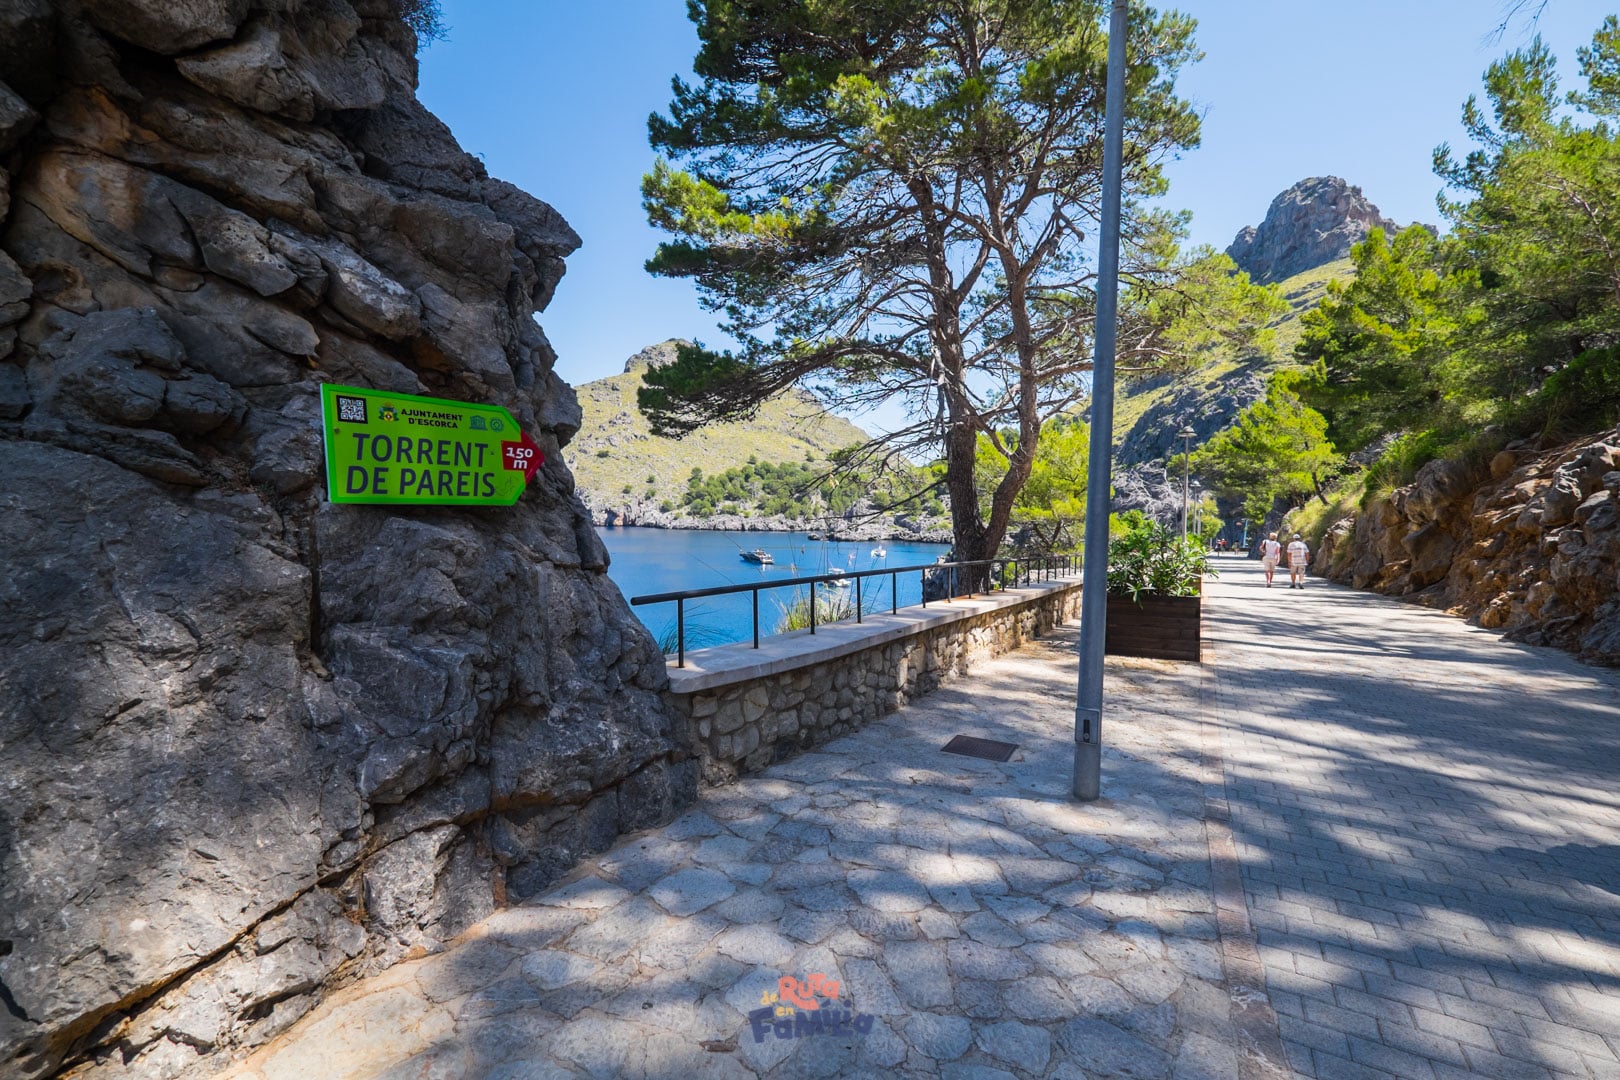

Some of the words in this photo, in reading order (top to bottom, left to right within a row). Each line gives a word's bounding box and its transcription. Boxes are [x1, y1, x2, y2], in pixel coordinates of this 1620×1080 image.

[401, 408, 463, 420] AJUNTAMENT
[408, 417, 458, 429] D'ESCORCA
[352, 432, 489, 468] TORRENT
[505, 446, 534, 459] 150
[513, 459, 528, 470] m
[346, 465, 390, 495] DE
[399, 468, 496, 498] PAREIS
